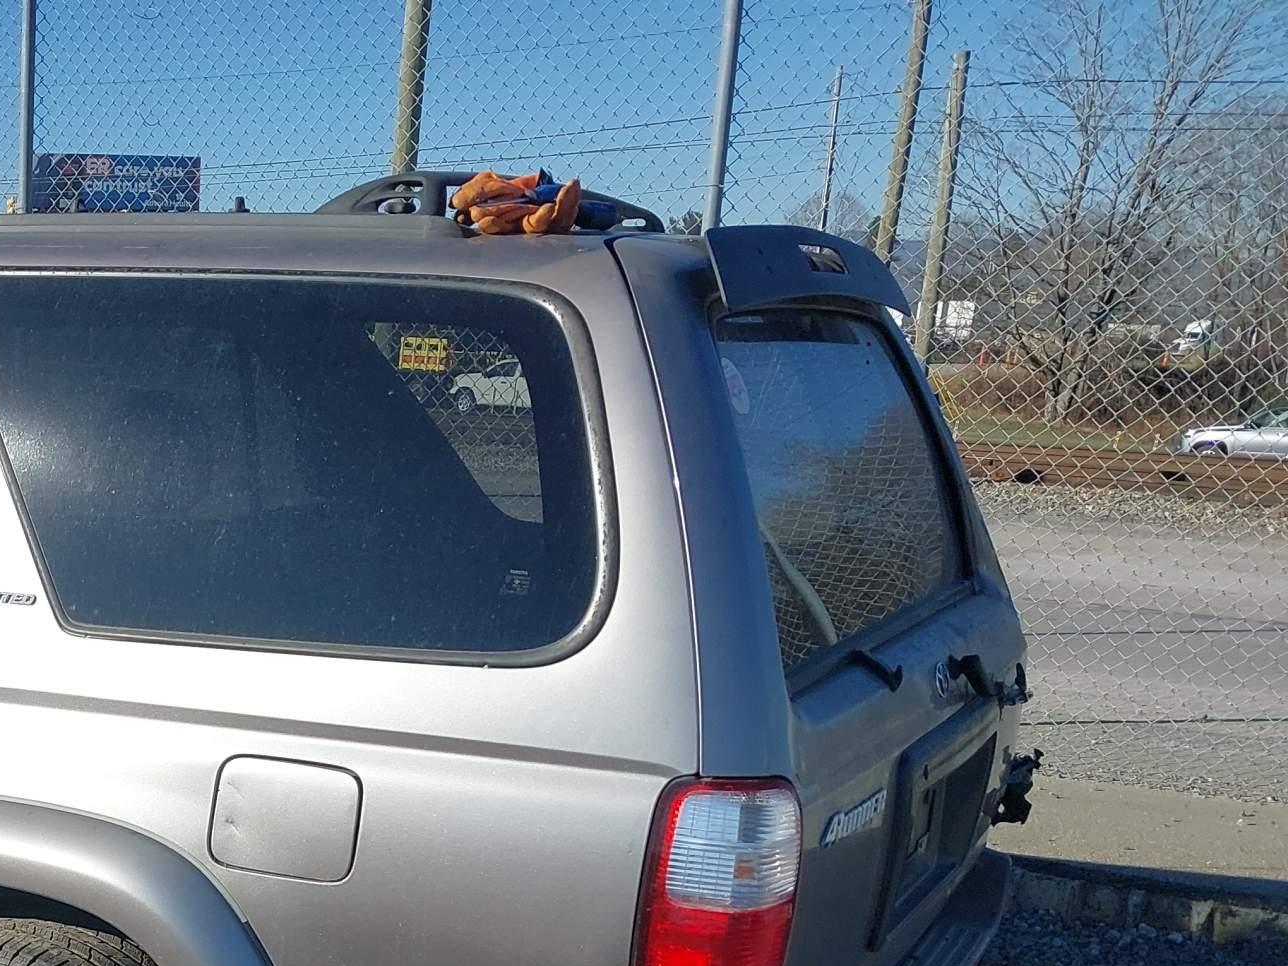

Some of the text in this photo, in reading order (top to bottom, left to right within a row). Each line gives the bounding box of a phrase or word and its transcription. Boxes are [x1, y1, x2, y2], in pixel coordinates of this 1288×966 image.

[86, 157, 184, 178] ER care you
